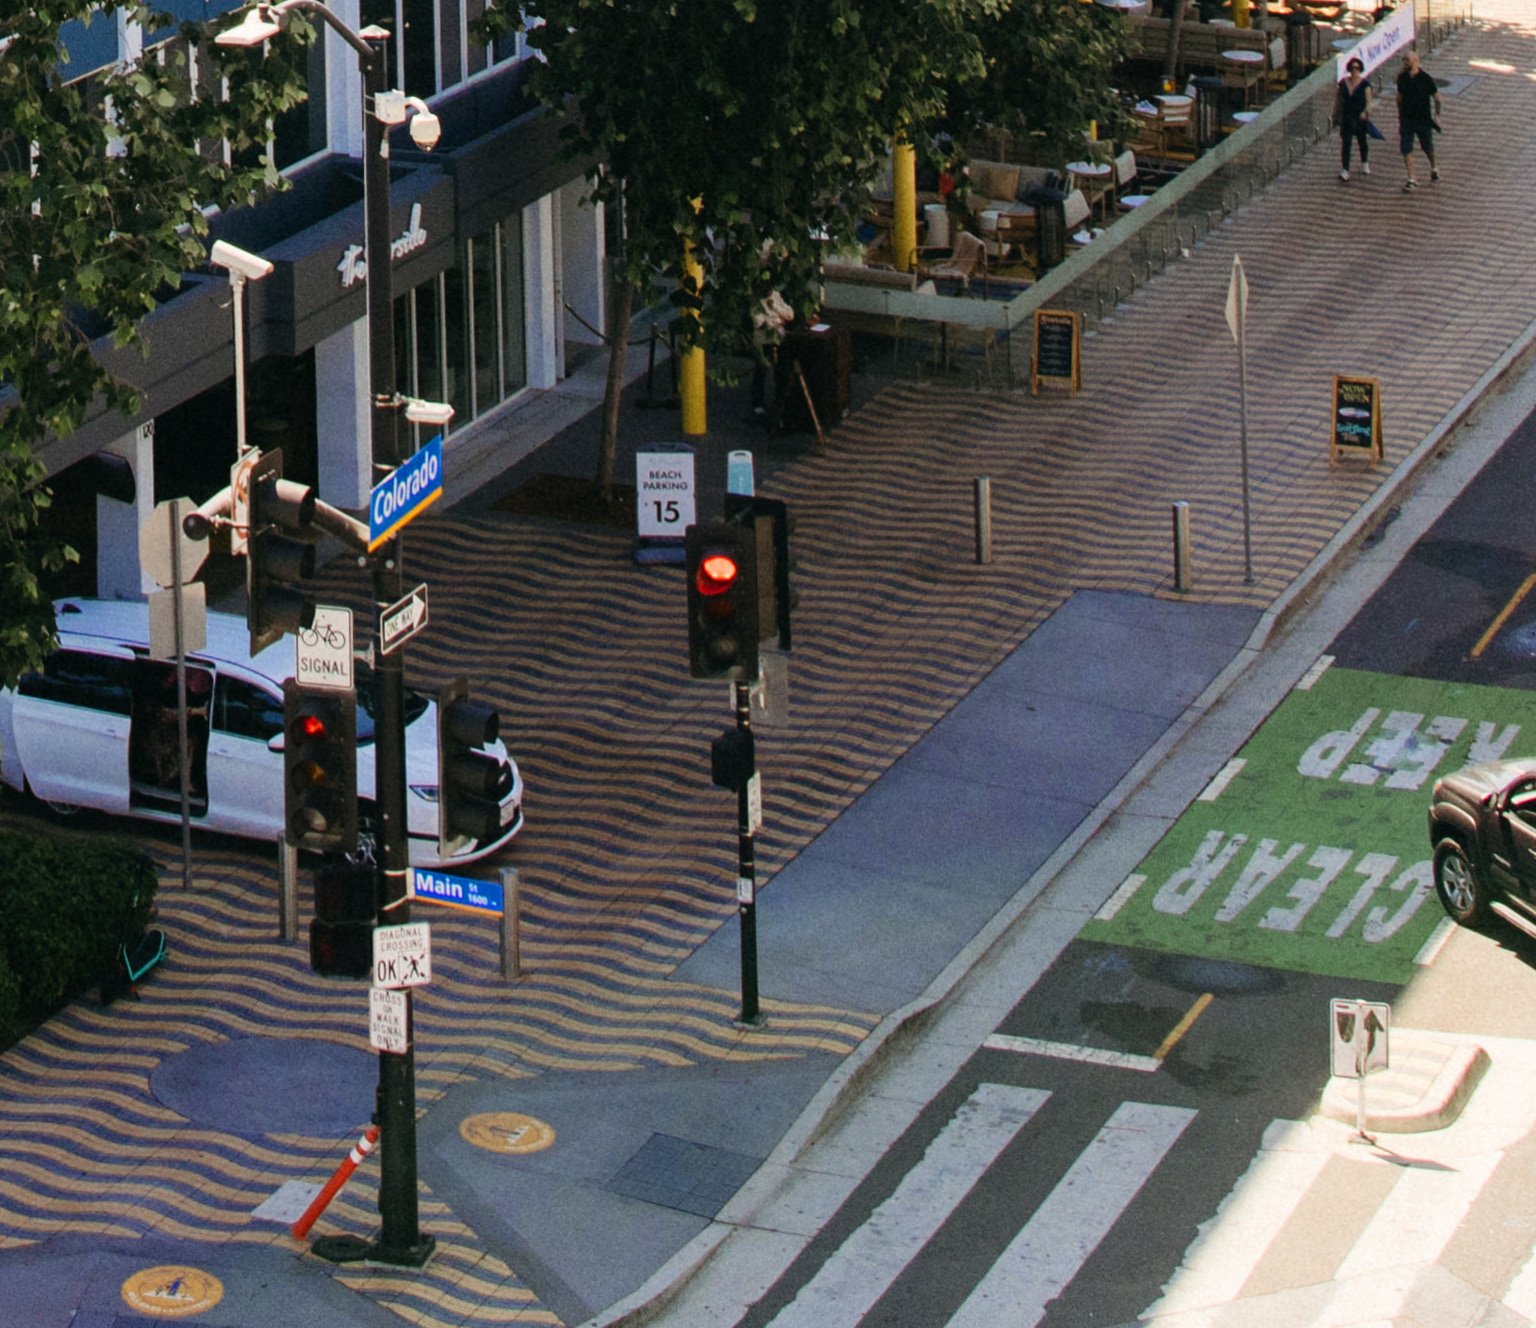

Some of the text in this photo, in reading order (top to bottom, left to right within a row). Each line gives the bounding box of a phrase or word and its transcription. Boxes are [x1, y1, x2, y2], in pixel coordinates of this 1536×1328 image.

[649, 470, 682, 480] BEACH
[374, 450, 438, 525] Colorado
[643, 481, 688, 491] PARKING
[653, 500, 680, 523] 15
[300, 656, 348, 677] SIGNAL
[416, 872, 478, 899] Main St
[1152, 830, 1435, 943] CLEAR
[380, 928, 423, 941] DIAGONAL
[381, 938, 423, 952] CROSSING
[378, 959, 396, 982] OK
[373, 991, 402, 1005] CROSS
[372, 1023, 403, 1037] SIGNAL
[377, 1034, 400, 1048] ONLY
